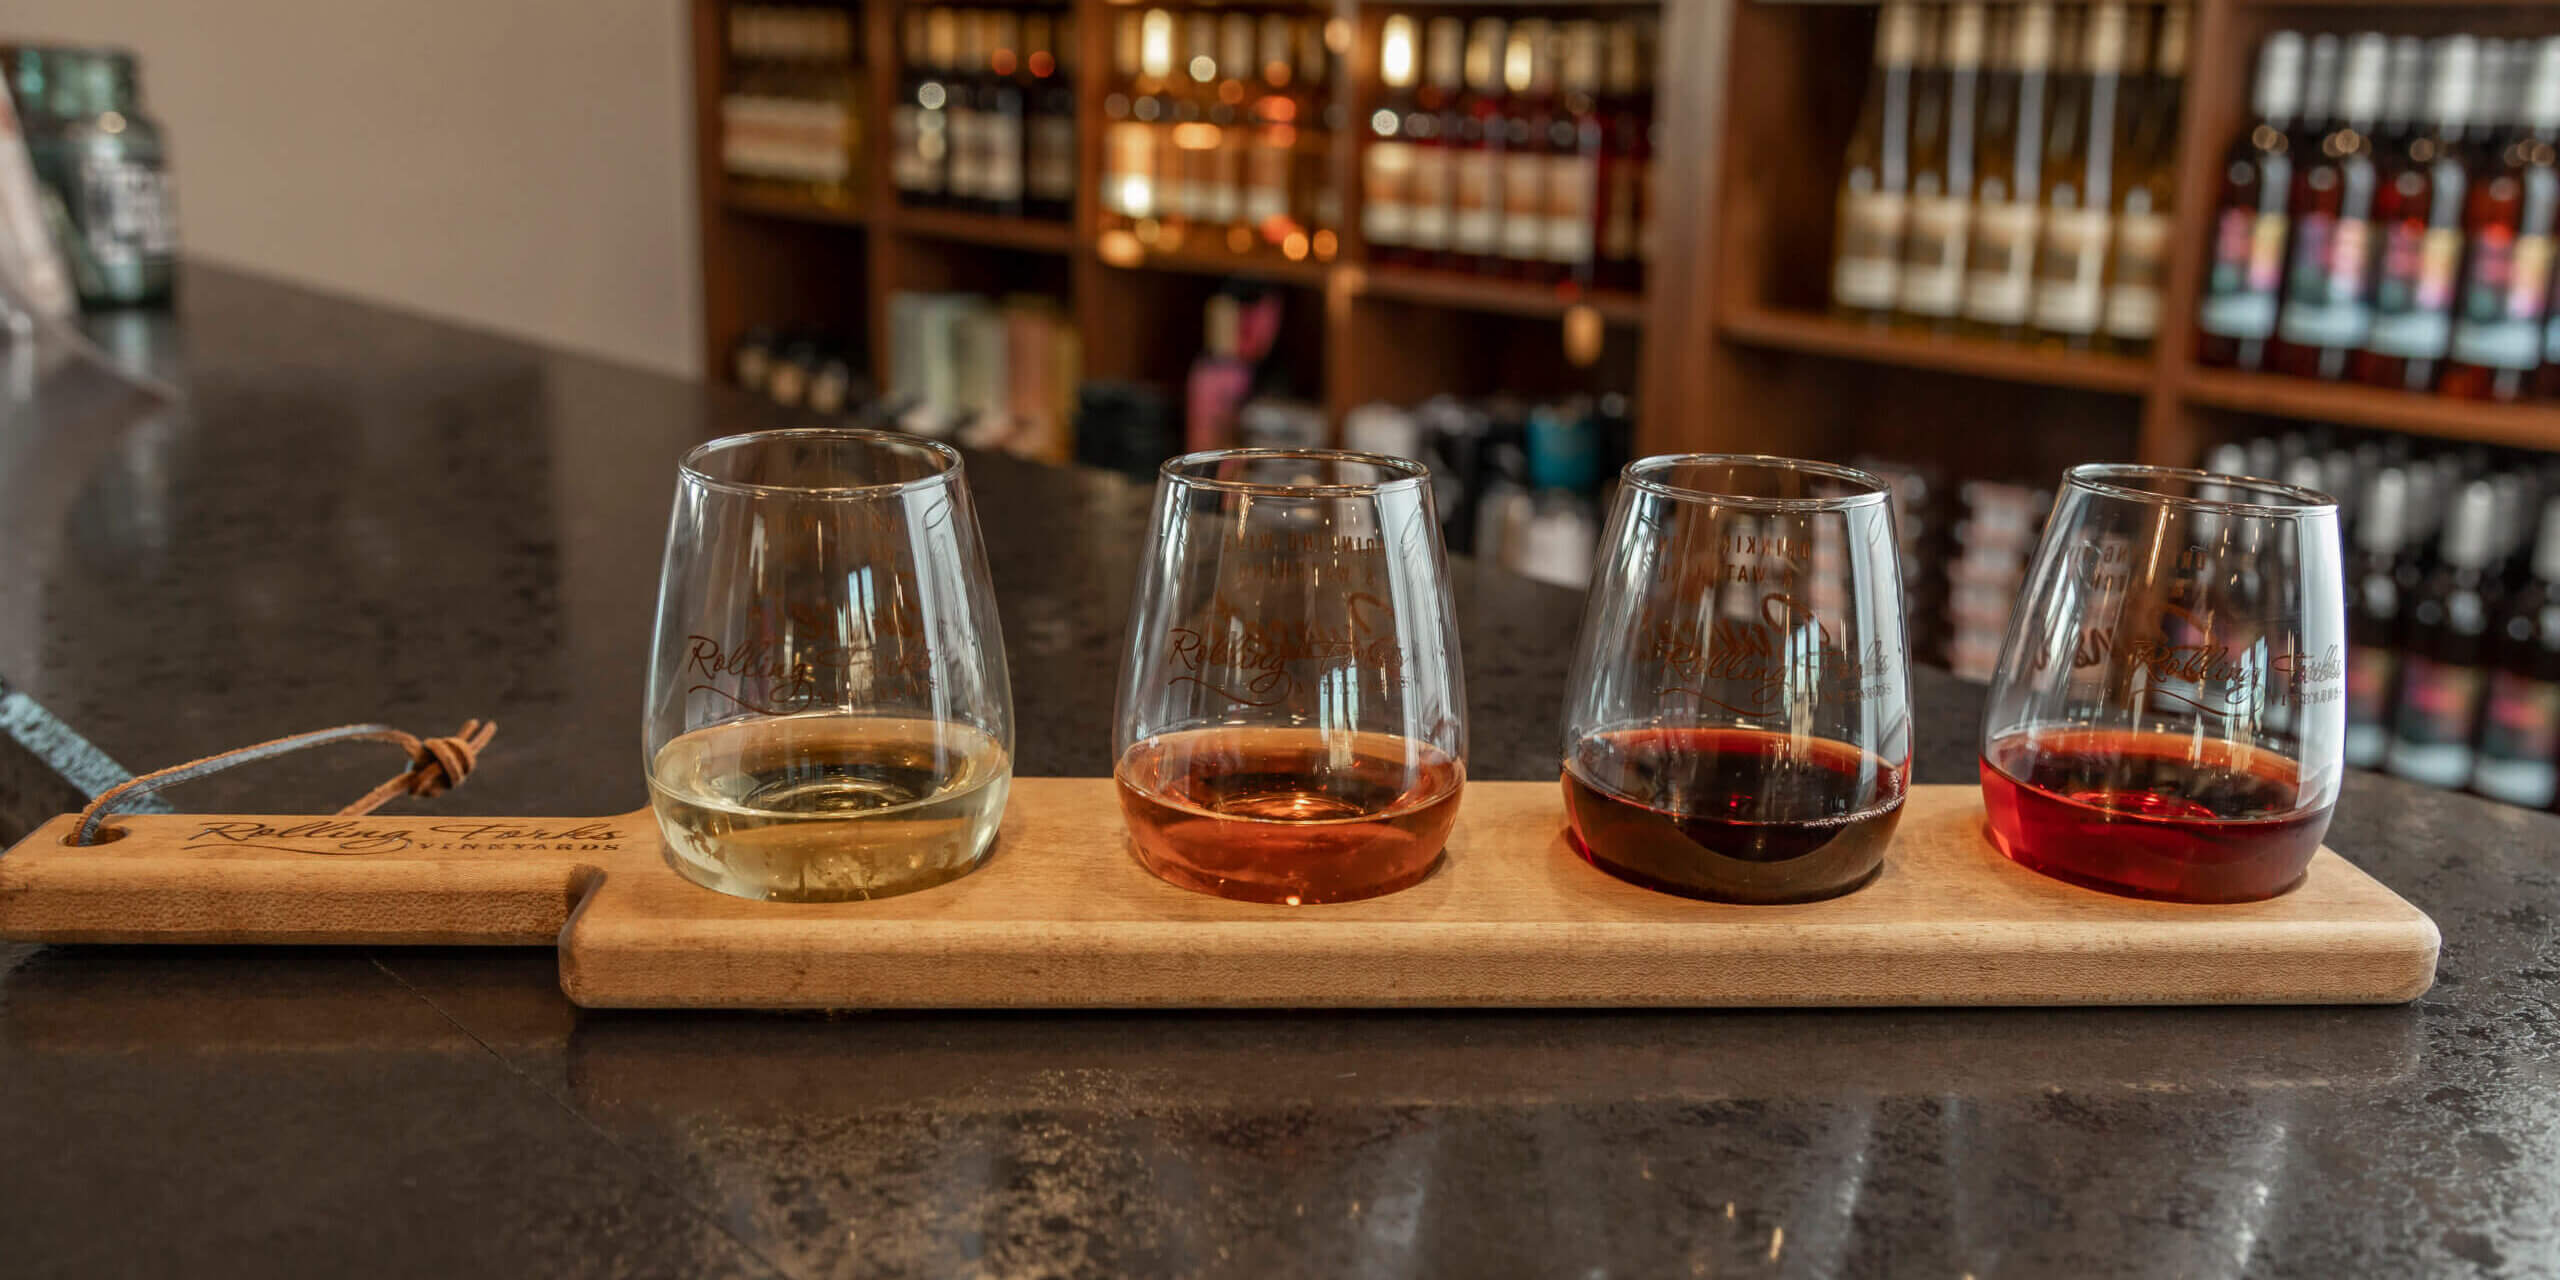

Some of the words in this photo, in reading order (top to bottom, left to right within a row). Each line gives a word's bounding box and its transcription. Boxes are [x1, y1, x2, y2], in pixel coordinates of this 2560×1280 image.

[687, 634, 813, 716] Rolling
[1167, 626, 1292, 708] Rolling
[1654, 641, 1790, 718] Rolling
[2132, 642, 2265, 717] Rolling
[180, 820, 414, 856] Rolling
[429, 823, 628, 841] Forks
[419, 842, 620, 851] VINEYARDS
